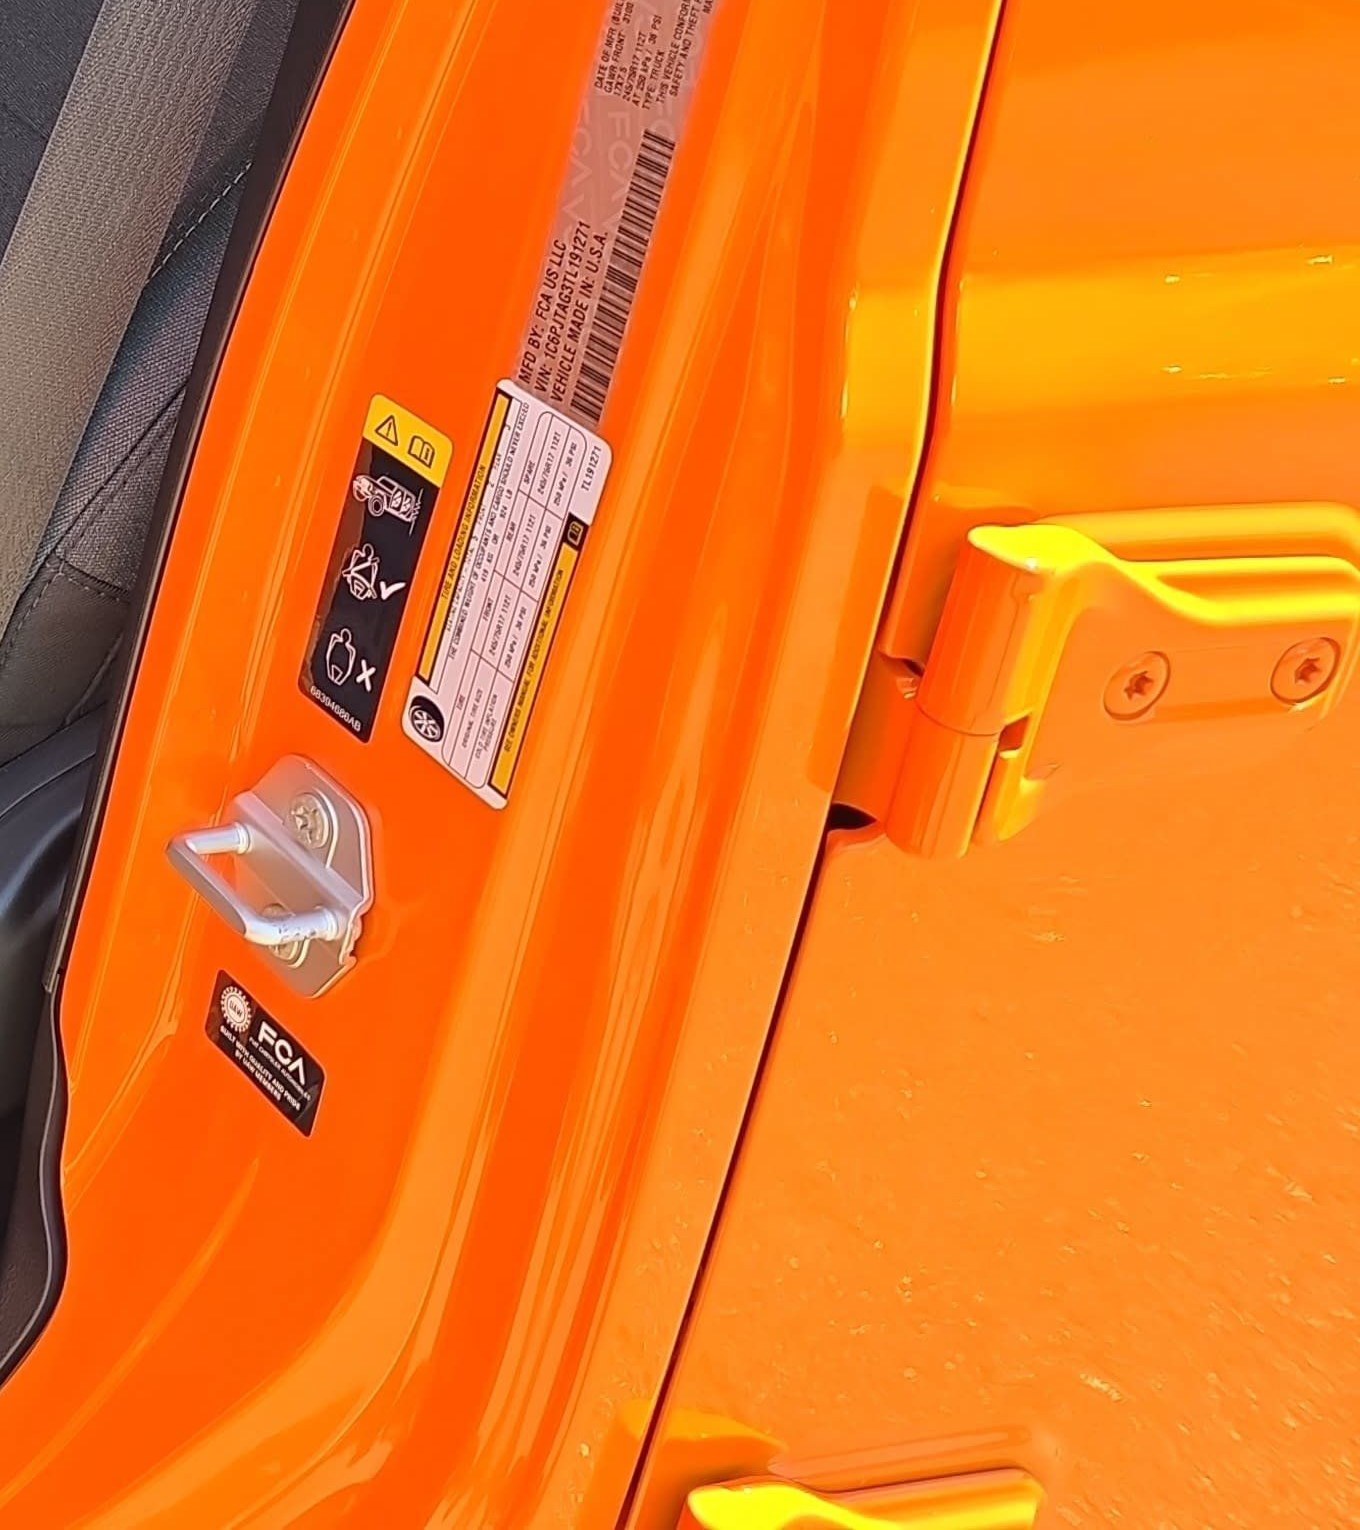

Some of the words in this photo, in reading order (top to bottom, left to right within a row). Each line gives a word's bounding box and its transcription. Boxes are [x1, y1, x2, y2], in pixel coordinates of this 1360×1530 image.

[649, 49, 664, 80] TRUCK
[669, 61, 684, 96] SAFETY
[679, 38, 691, 59] AND
[685, 5, 699, 35] THEFT
[655, 82, 668, 103] THIS
[662, 42, 679, 79] VEHICLE
[549, 239, 566, 267] LLC
[585, 232, 607, 273] U.S.A.
[542, 268, 558, 289] US
[578, 276, 594, 298] IN:
[534, 364, 552, 392] VIN:
[544, 221, 590, 359] 1C6PJTAG3TL191271
[535, 293, 552, 320] FCA
[567, 300, 588, 343] MADE
[527, 324, 544, 349] BY:
[518, 351, 536, 384] MFD
[550, 344, 576, 402] VEHICLE
[581, 445, 601, 490] TL191271
[441, 580, 451, 599] TIRE
[448, 561, 457, 579] AND
[453, 523, 468, 560] LOADING
[464, 465, 485, 522] INFORMATION
[257, 1021, 306, 1086] FCA
